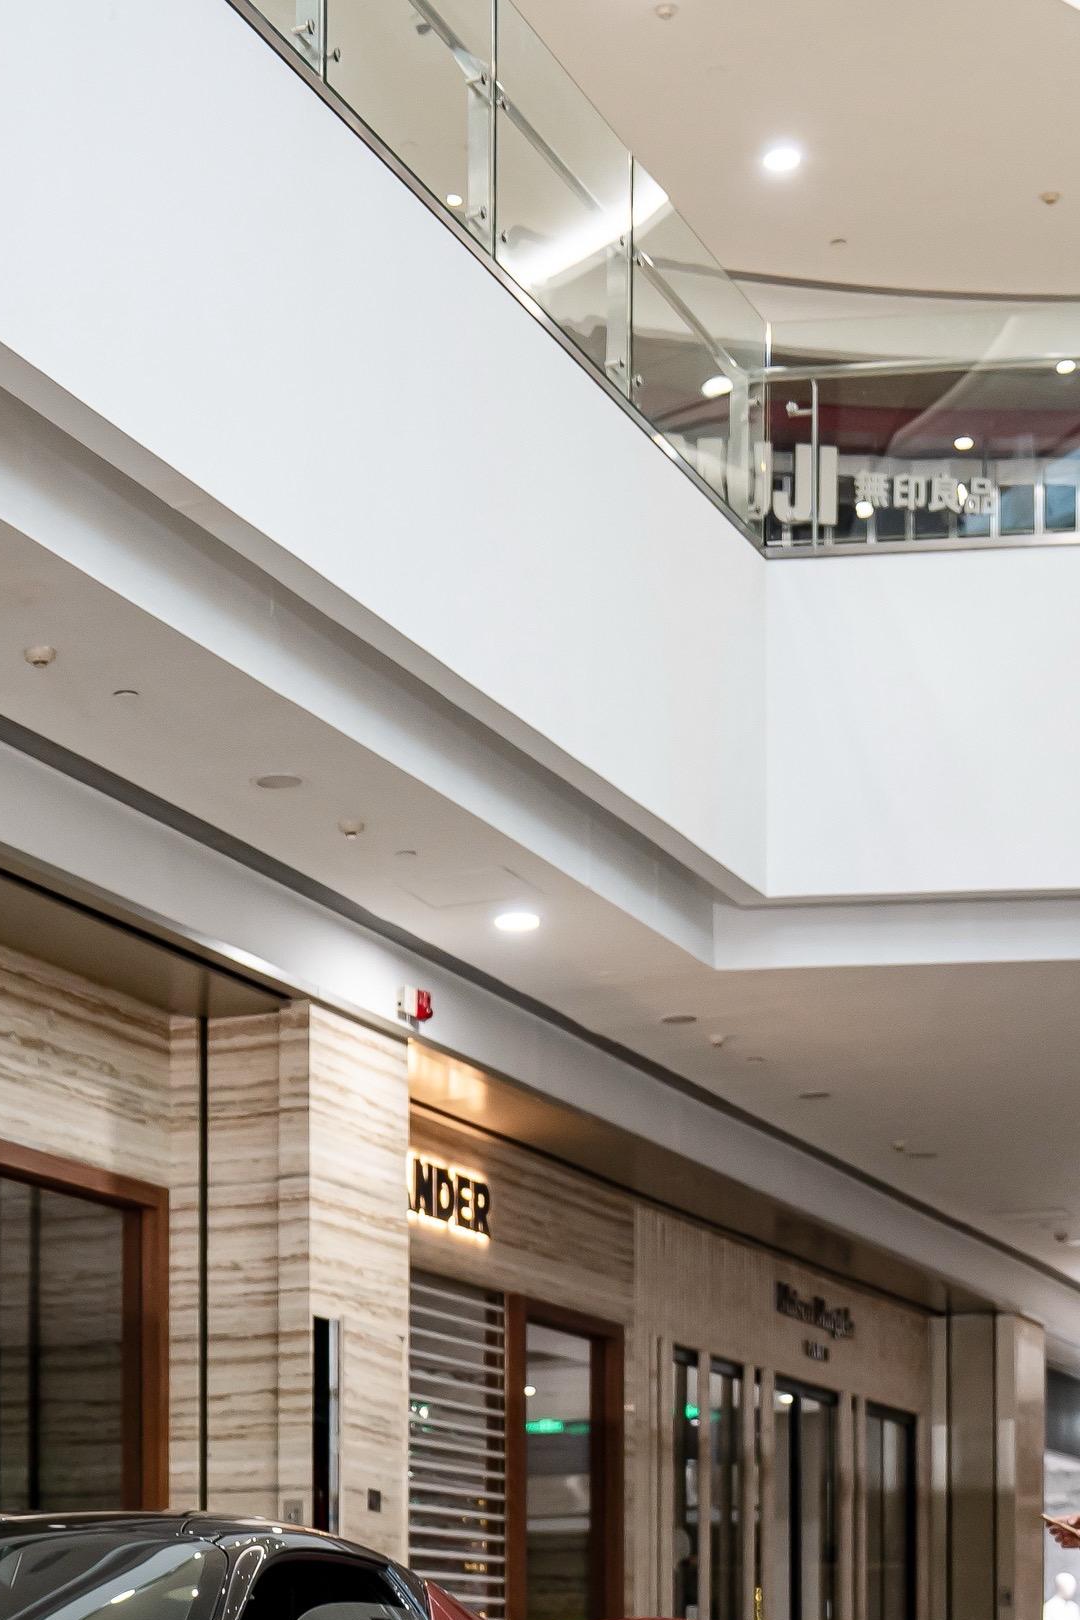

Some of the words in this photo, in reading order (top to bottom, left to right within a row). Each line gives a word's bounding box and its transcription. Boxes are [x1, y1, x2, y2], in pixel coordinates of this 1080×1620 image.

[853, 471, 996, 515] 無印良品
[408, 1158, 491, 1240] NDER
